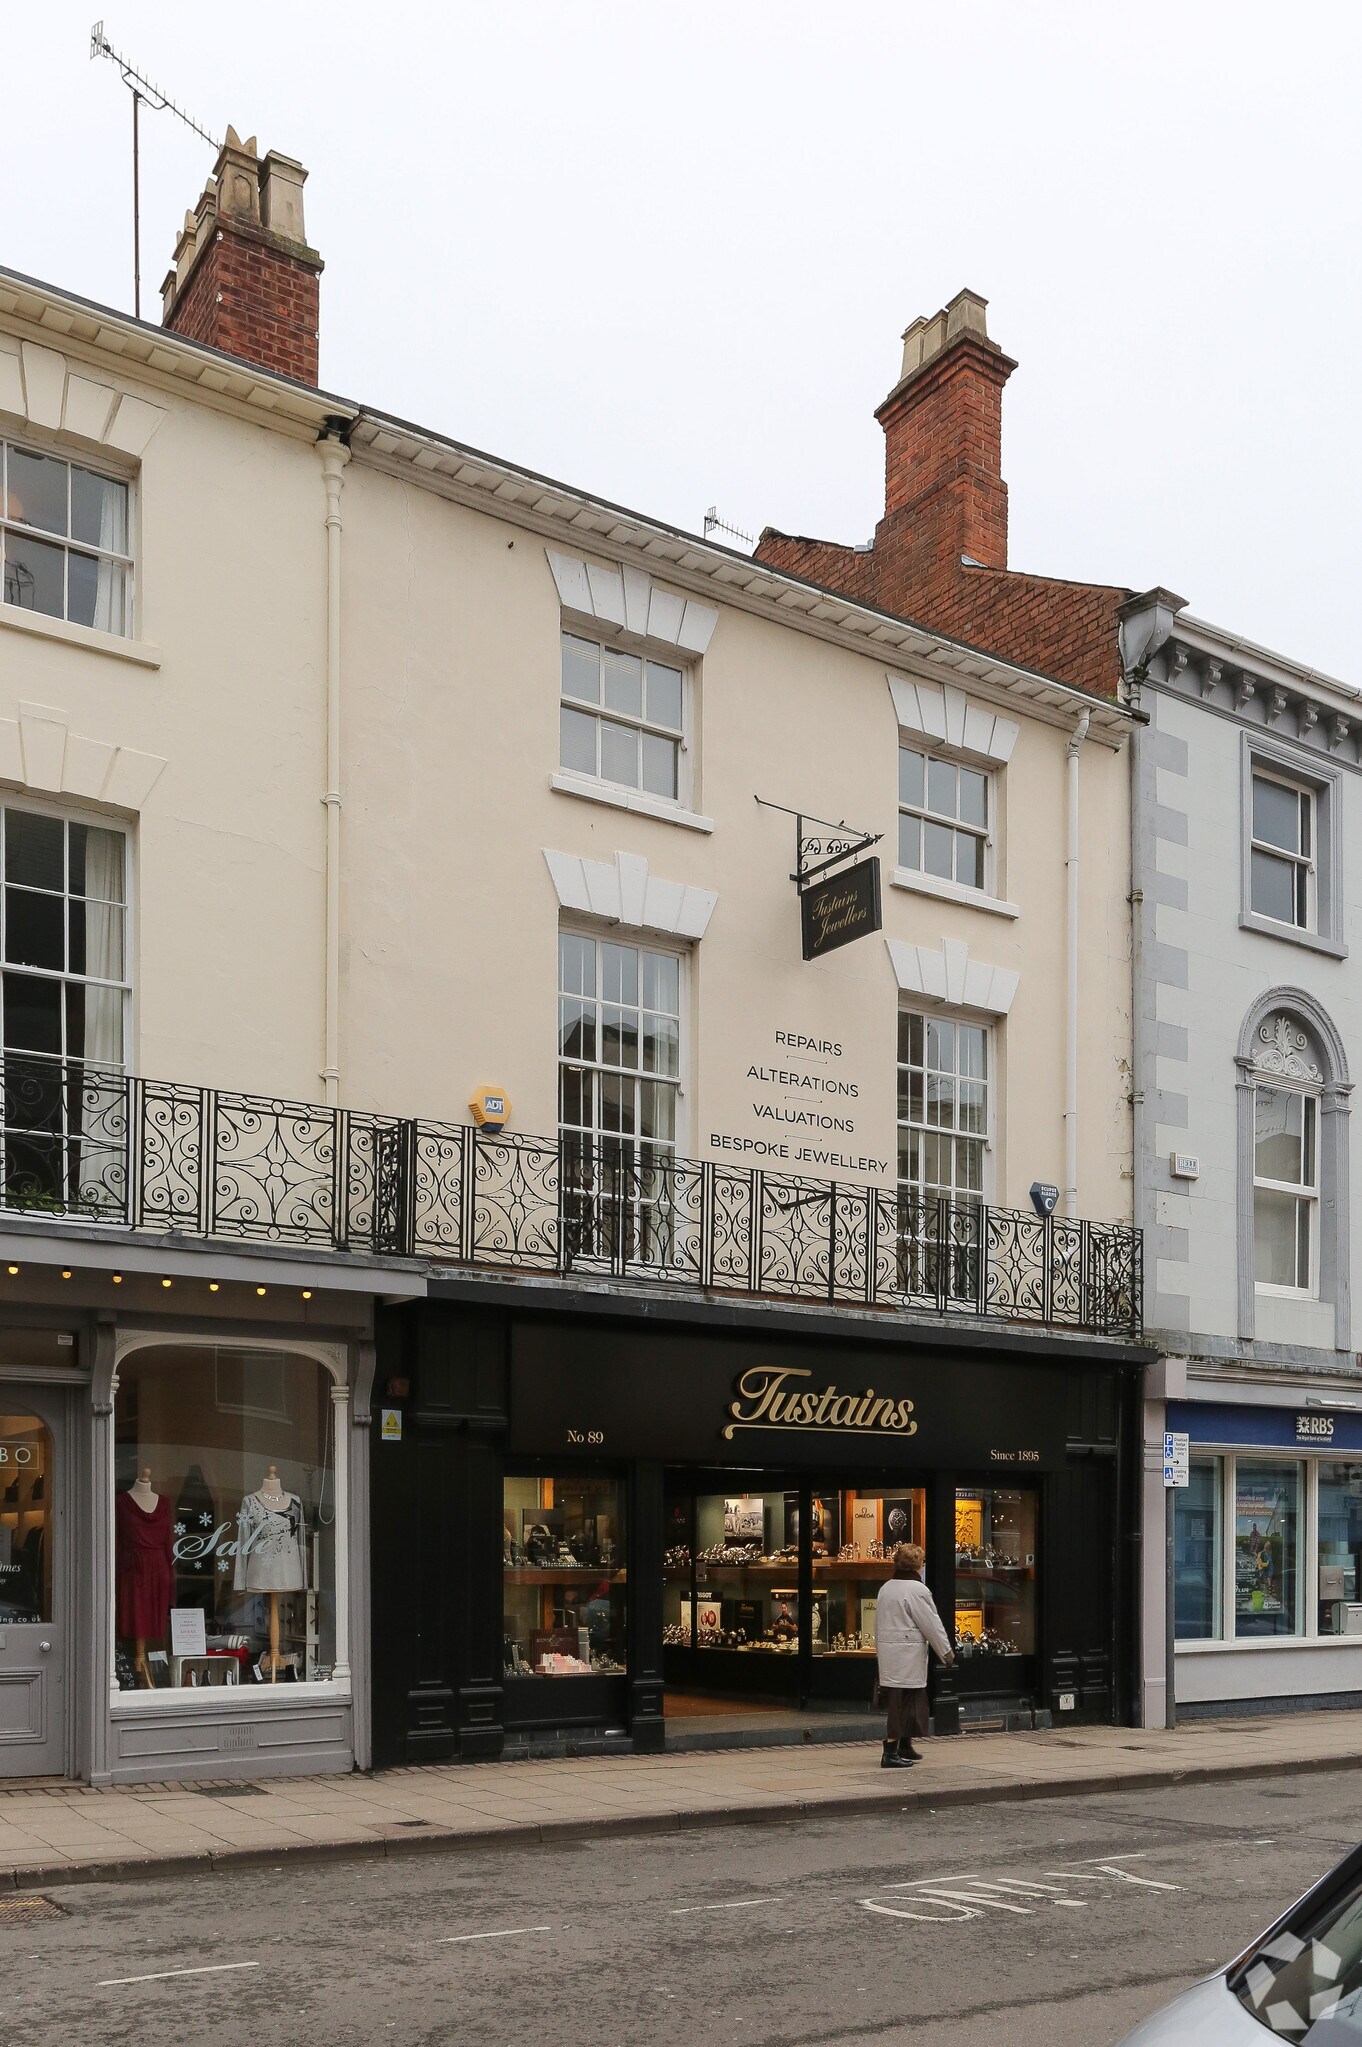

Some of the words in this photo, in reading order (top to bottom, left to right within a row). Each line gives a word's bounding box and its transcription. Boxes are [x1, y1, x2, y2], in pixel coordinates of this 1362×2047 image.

[812, 890, 858, 921] Tustains
[814, 904, 867, 948] Jewellers
[775, 1030, 843, 1057] REPAIRS
[746, 1065, 859, 1098] ALTERATIONS
[486, 1100, 503, 1111] ADT
[752, 1103, 854, 1133] VALUATIONS
[710, 1133, 789, 1159] BESPOKE
[794, 1147, 888, 1174] JEWELLERY
[728, 1365, 916, 1434] Tustains
[567, 1430, 584, 1443] No
[587, 1431, 604, 1443] 89
[1166, 1435, 1173, 1445] P
[1311, 1417, 1334, 1435] RBS
[991, 1450, 1015, 1460] Since
[1018, 1451, 1040, 1461] 1895
[172, 1521, 274, 1565] Sale
